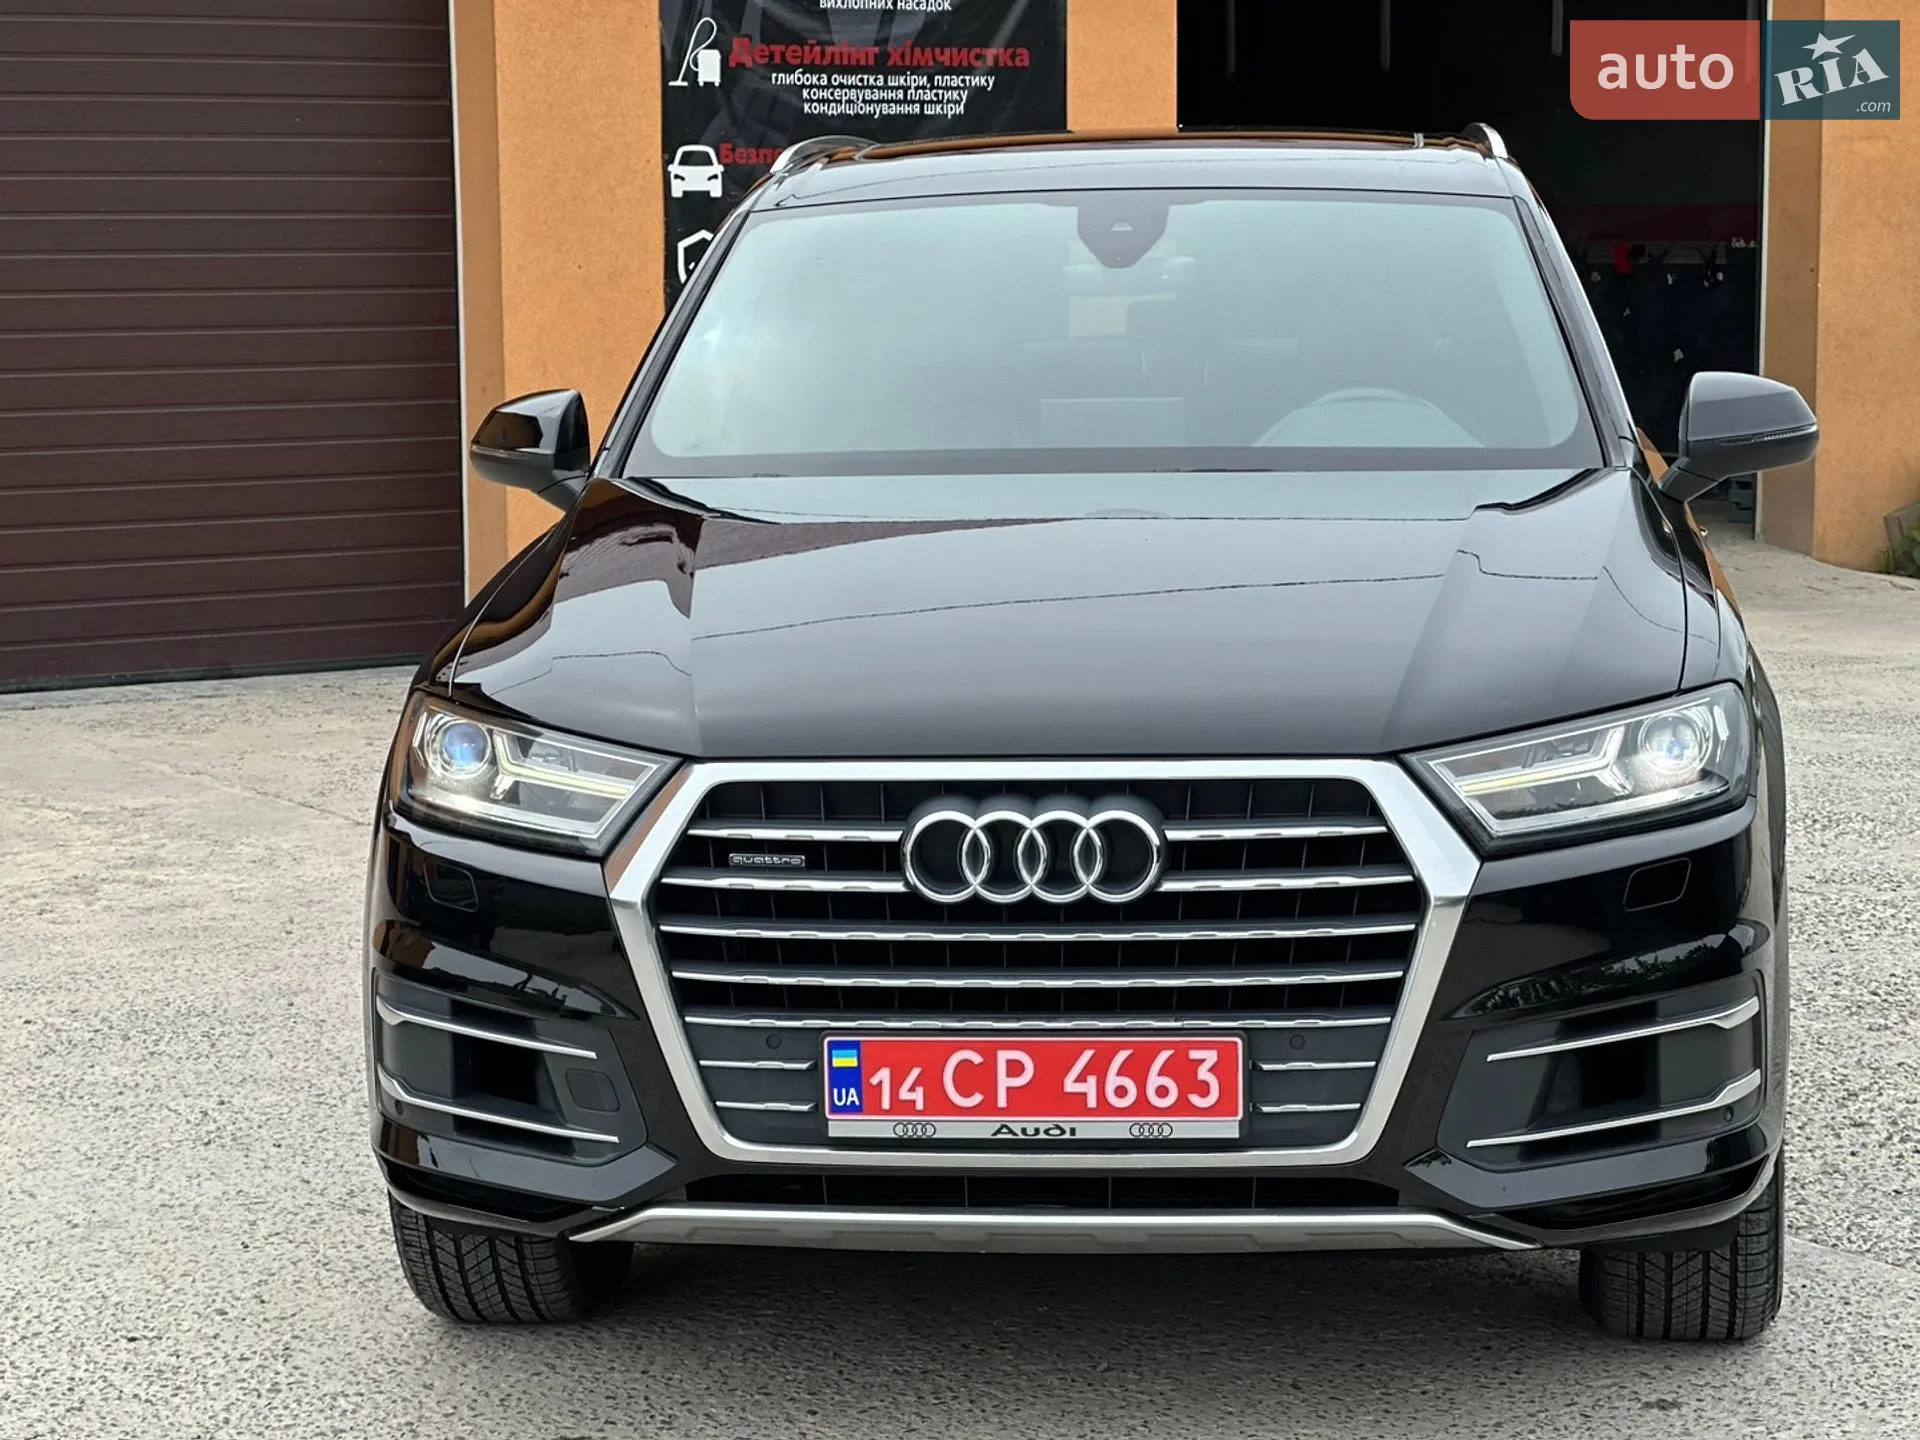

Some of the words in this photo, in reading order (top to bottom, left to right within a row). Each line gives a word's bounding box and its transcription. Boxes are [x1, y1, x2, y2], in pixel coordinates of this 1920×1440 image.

[897, 0, 952, 12] насадок
[729, 37, 879, 68] Детейлінг
[887, 40, 1030, 68] хімчистка
[771, 69, 827, 86] глибока
[831, 74, 883, 86] очистка
[888, 72, 931, 90] шкіри,
[934, 74, 995, 91] пластику
[802, 88, 904, 103] консервування
[907, 88, 968, 104] пластику
[804, 101, 919, 118] кондиціонування
[923, 101, 964, 118] шкіри
[732, 855, 801, 865] quattro
[869, 1066, 925, 1111] 14
[943, 1049, 1035, 1110] CP
[1063, 1049, 1221, 1110] 4663
[832, 1088, 859, 1106] UA
[990, 1123, 1077, 1138] Audi
